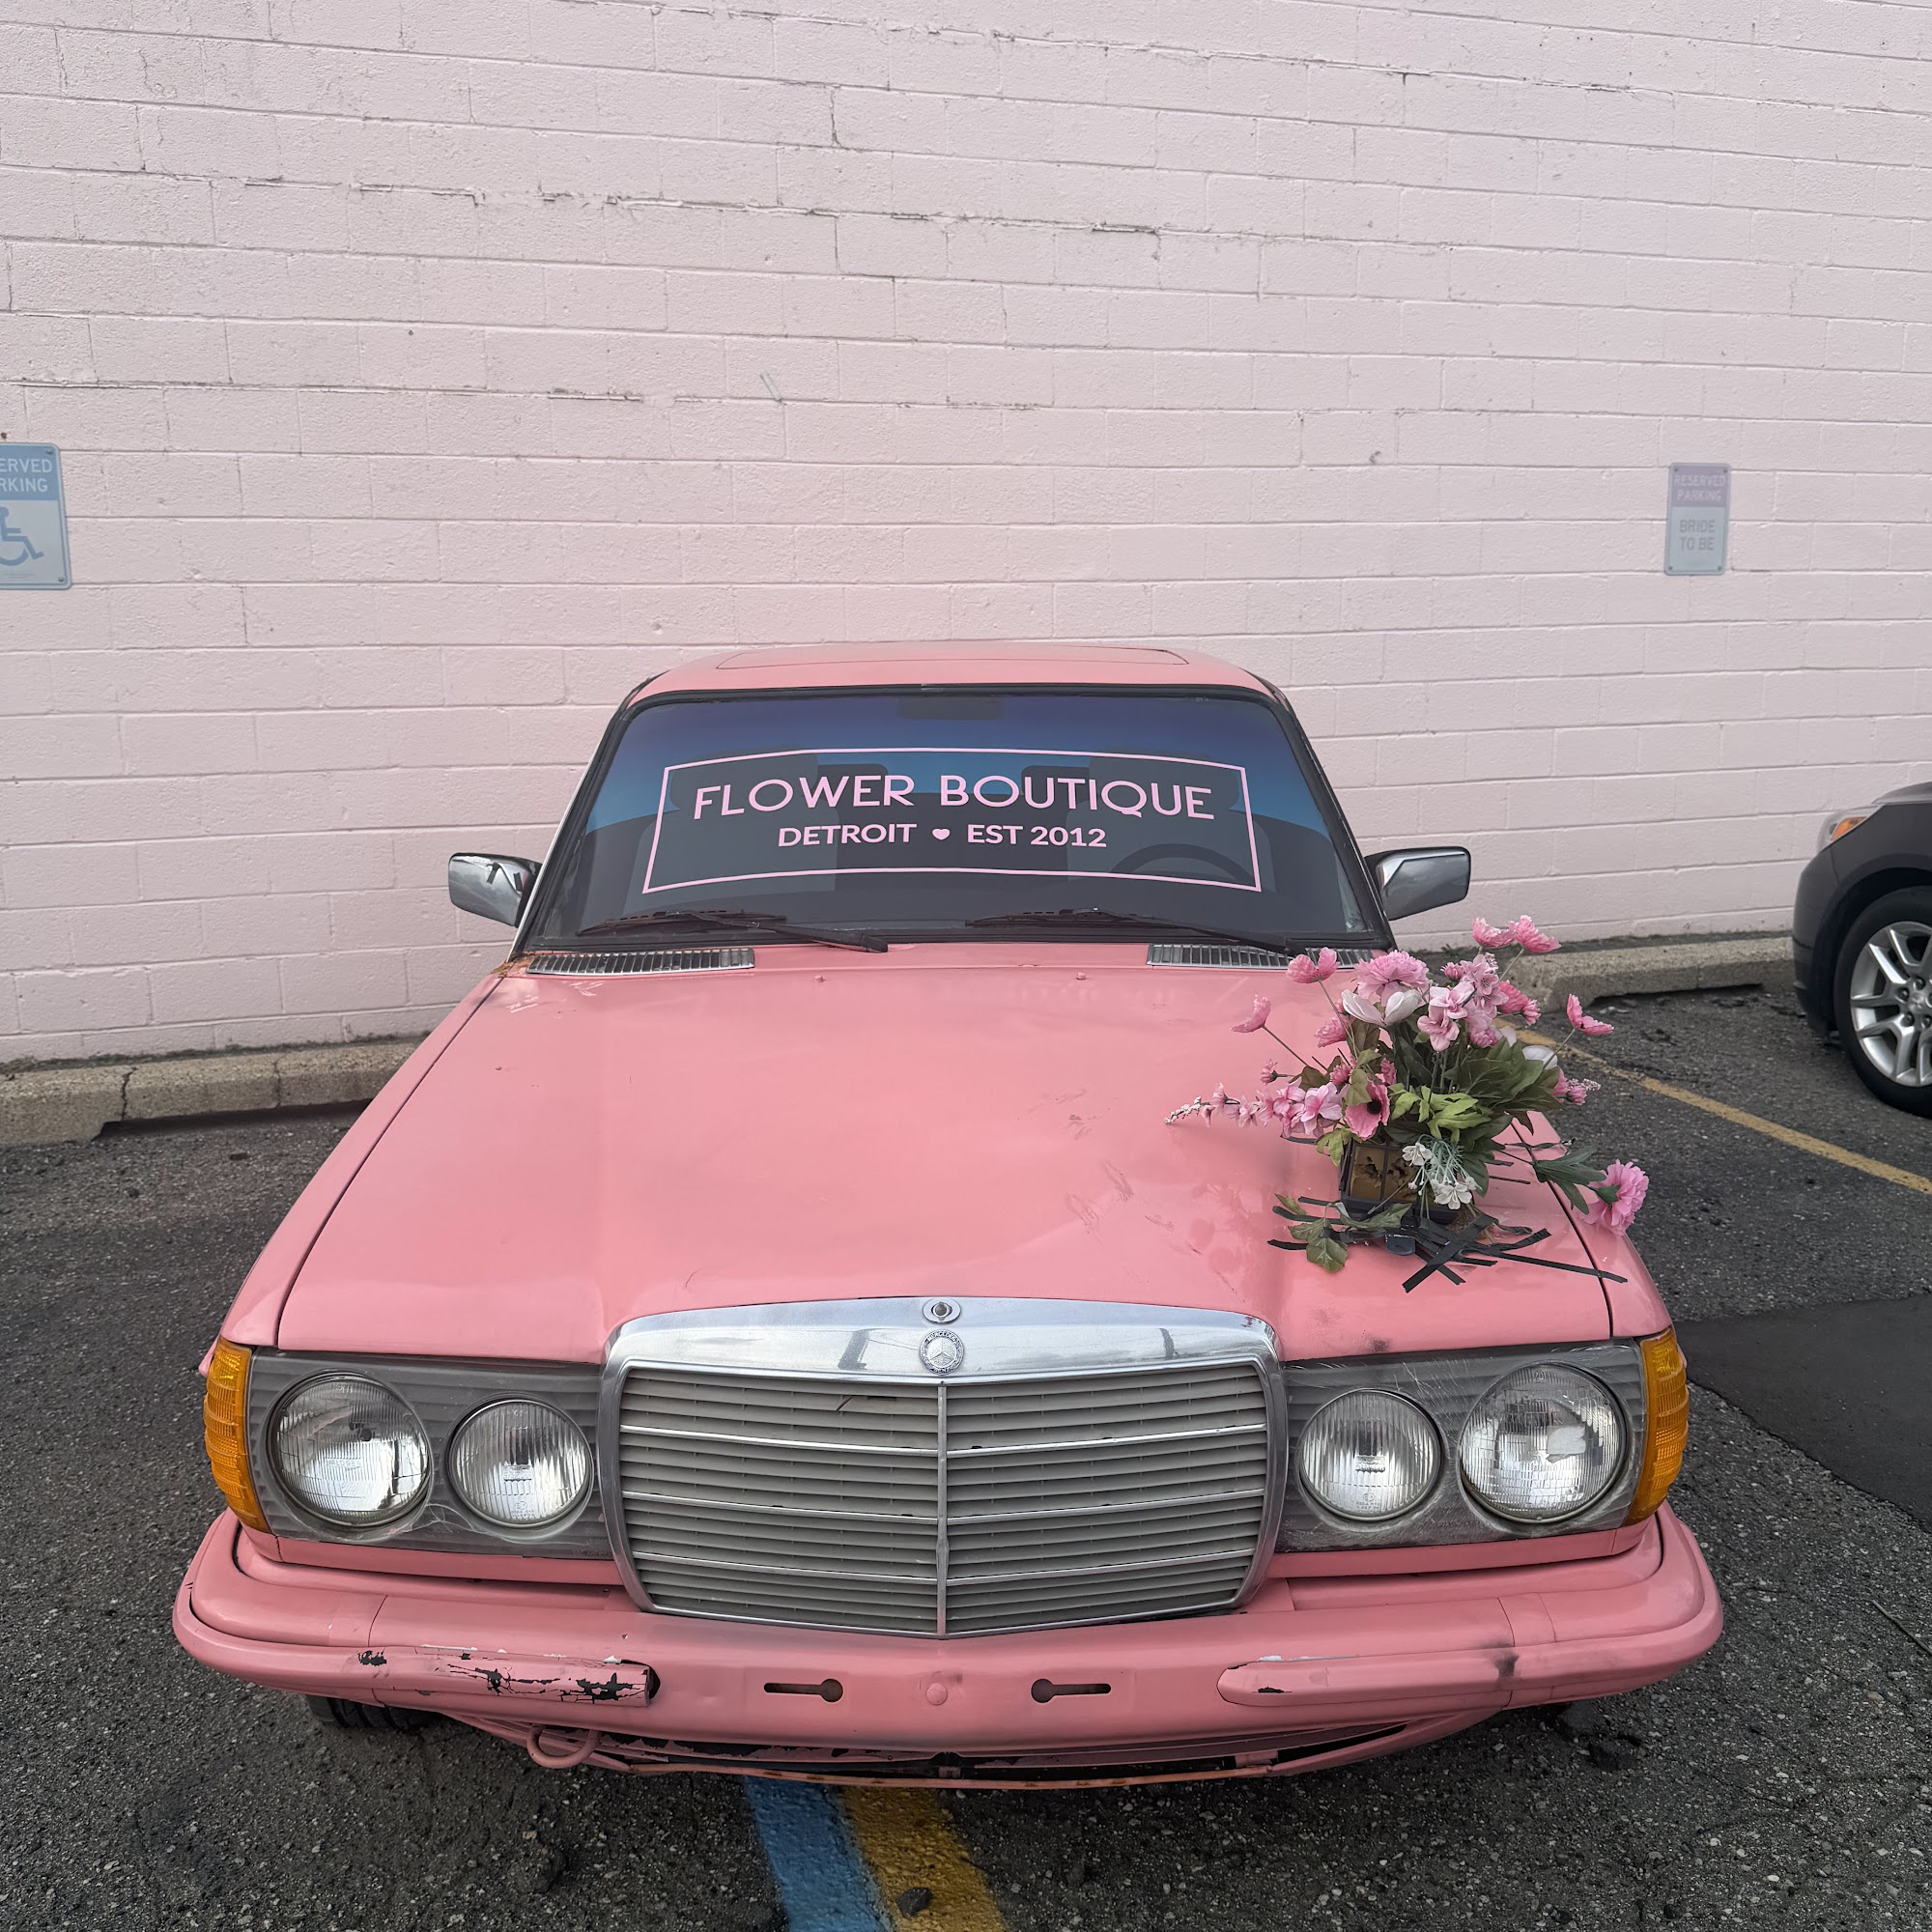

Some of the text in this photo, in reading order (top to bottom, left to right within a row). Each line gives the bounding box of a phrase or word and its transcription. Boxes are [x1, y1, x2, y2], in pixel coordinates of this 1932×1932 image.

[0, 458, 52, 473] ERVED
[1674, 474, 1725, 487] RESERVED
[1677, 489, 1721, 501] PARKING
[1679, 520, 1716, 533] BRIDE
[1679, 537, 1715, 551] TO BE
[694, 775, 1214, 820] FLOWER BOUTIQUE
[778, 823, 1106, 847] DETROIT EST 2012
